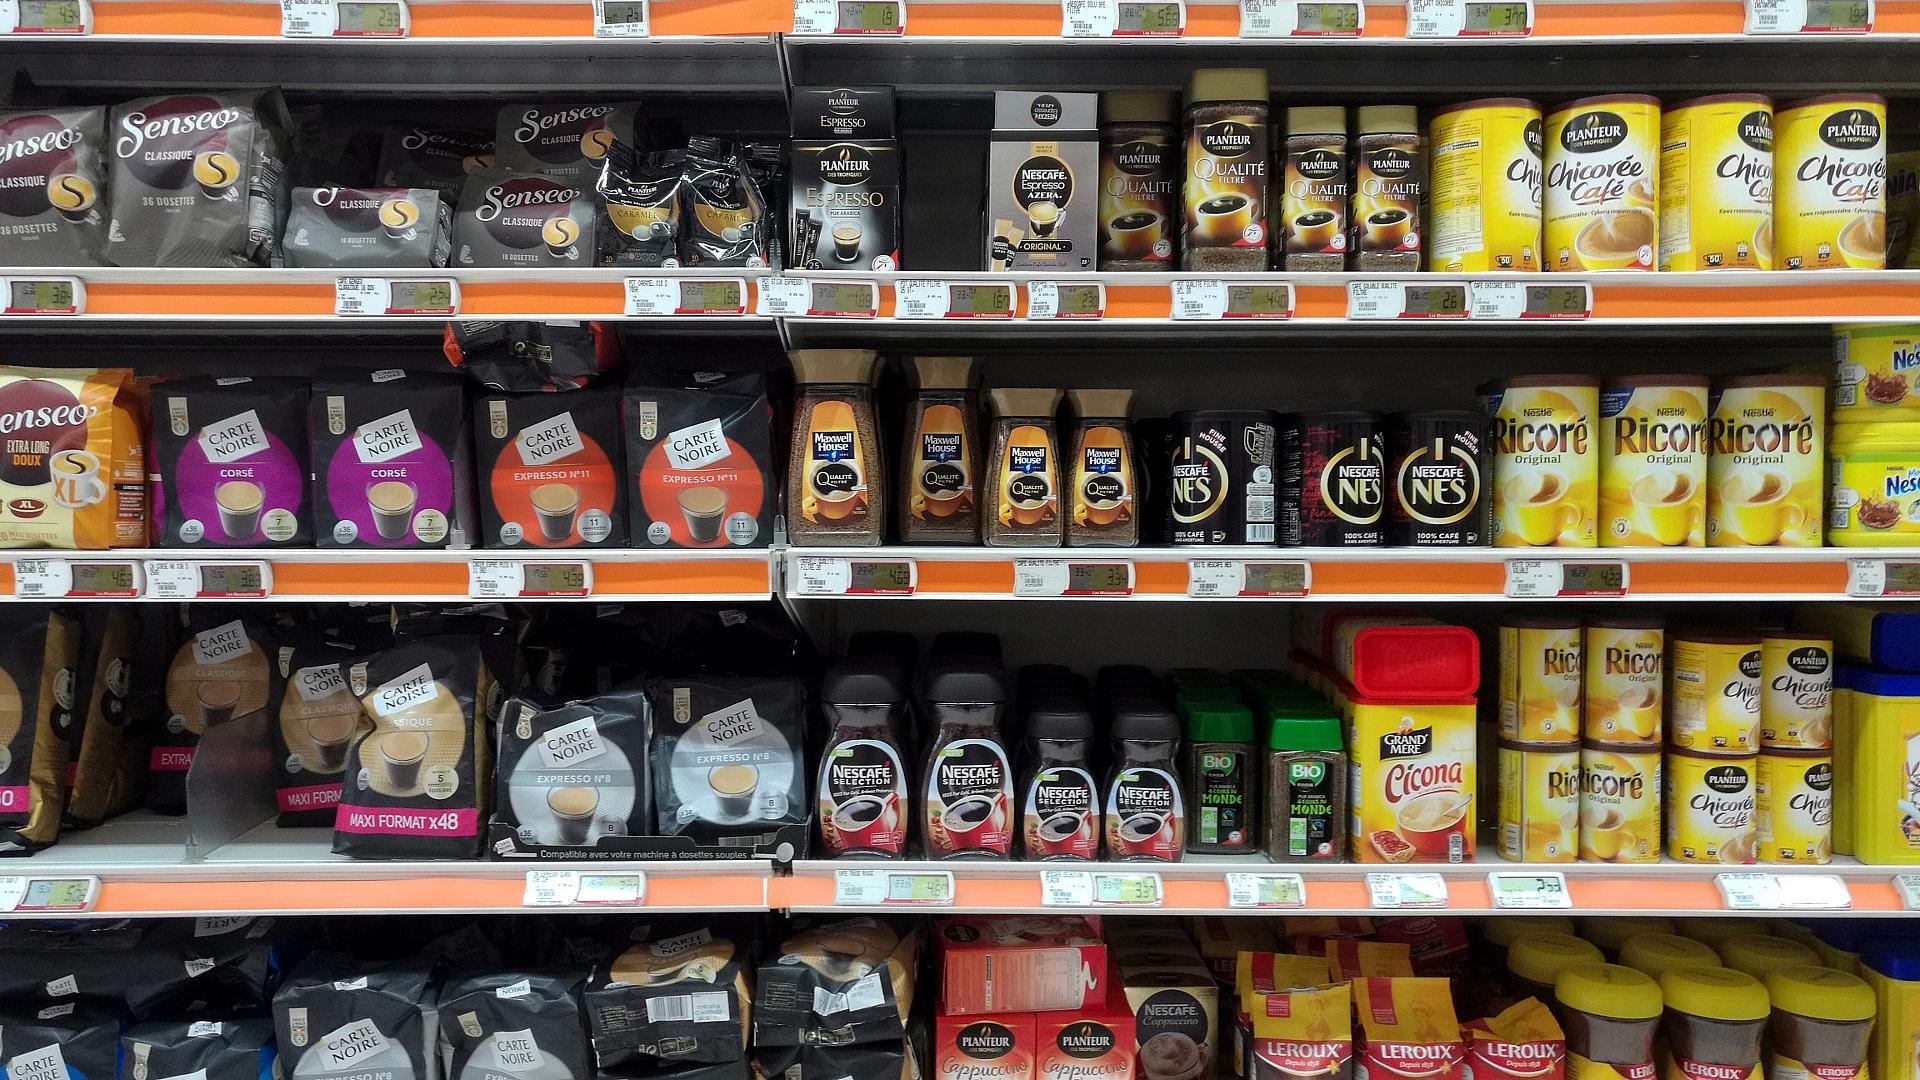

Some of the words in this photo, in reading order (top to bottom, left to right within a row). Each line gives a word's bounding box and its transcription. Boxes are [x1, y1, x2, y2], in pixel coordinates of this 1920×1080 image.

[827, 98, 859, 106] PLANTEUR
[820, 116, 866, 128] ESPRESSO
[116, 109, 239, 158] Senseo
[1566, 126, 1621, 143] PLANTEUR
[1827, 125, 1878, 137] PLANTEUR
[541, 134, 580, 145] CLASSIQUE
[1206, 134, 1251, 145] PLANTEUR
[145, 151, 193, 161] CLASSIQUE
[1119, 154, 1160, 164] PLANTEUR
[820, 159, 870, 171] PLANTEUR
[1194, 158, 1264, 182] QUALITÉ
[1301, 161, 1338, 170] PLANTEUR
[1373, 160, 1410, 169] PLANTEUR
[1548, 154, 1643, 190] Chicorée
[1022, 180, 1065, 192] Espresso
[1218, 176, 1245, 184] FILTRE
[1107, 176, 1173, 198] QUALITÉ
[1290, 179, 1347, 200] QUALITÉ
[1362, 178, 1420, 199] QUALITÉ
[1570, 179, 1624, 205] Café
[1832, 178, 1879, 203] Café
[157, 196, 195, 206] DOSETTES
[475, 186, 580, 221] Senseo
[805, 187, 884, 208] ESPRESSO
[340, 200, 379, 209] CLASSIQUE
[13, 222, 58, 234] DOSETTES
[502, 217, 543, 227] CLASSIQUE
[1024, 242, 1062, 250] ORIGINAL
[1501, 256, 1510, 265] 50
[1523, 408, 1553, 417] Nestlé
[1656, 407, 1685, 417] Nestlé
[1743, 408, 1775, 417] Nestlé
[208, 421, 255, 445] CARTE
[363, 420, 408, 445] CARTE
[526, 422, 570, 449] CARTE
[814, 432, 852, 443] Maxwell
[1209, 428, 1226, 442] FINE
[1464, 429, 1478, 443] FINE
[1493, 415, 1588, 455] Ricoré
[1615, 416, 1706, 456] Ricoré
[1708, 416, 1813, 456] Ricoré
[215, 433, 260, 458] NOIRE
[368, 433, 413, 458] NOIRE
[673, 429, 716, 453] CARTE
[924, 435, 959, 445] Maxwell
[1199, 432, 1227, 453] MOUSSE
[1454, 434, 1479, 455] MOUSSE
[7, 440, 28, 454] EXTRA
[30, 440, 50, 454] LONG
[531, 434, 574, 460] NOIRE
[678, 441, 722, 464] NOIRE
[818, 442, 848, 451] House
[928, 443, 956, 452] House
[1012, 448, 1044, 457] Maxwell
[1087, 448, 1119, 458] Maxwell
[13, 454, 41, 466] DOUX
[1015, 456, 1041, 464] House
[1090, 457, 1116, 465] House
[1515, 454, 1561, 465] Original
[1646, 455, 1692, 465] Original
[1733, 454, 1784, 466] Original
[220, 468, 254, 478] CORSÉ
[371, 467, 407, 478] CORSÉ
[514, 470, 567, 480] EXPRESSO
[663, 474, 714, 483] EXPRESSO
[925, 471, 959, 486] QUALITÉ
[1012, 481, 1043, 496] QUALITÉ
[1087, 481, 1118, 496] QUALITÉ
[1173, 477, 1211, 503] NES
[1339, 479, 1381, 505] NES
[1412, 478, 1466, 505] NES
[1187, 530, 1204, 538] CAFÉ
[200, 628, 240, 649] CARTE
[203, 640, 244, 659] NOIRE
[1792, 655, 1827, 665] PLANTEUR
[382, 675, 426, 700] CARTE
[708, 708, 751, 733] CARTE
[712, 719, 756, 744] NOIRE
[547, 727, 592, 751] CARTE
[552, 738, 598, 763] NOIRE
[161, 754, 192, 765] EXTRA
[697, 753, 750, 763] EXPRESSO
[753, 752, 769, 762] N°8
[438, 774, 444, 783] 5
[537, 774, 591, 784] EXPRESSO
[943, 778, 999, 786] SELECTION
[1384, 761, 1463, 804] Cicona
[1709, 774, 1746, 784] PLANTEUR
[288, 793, 310, 805] MAXI
[1203, 794, 1242, 804] MONDE
[1290, 805, 1332, 815] MONDE
[350, 813, 375, 828] MAXI
[379, 814, 426, 829] FORMAT
[428, 812, 458, 830] x48
[540, 849, 586, 860] Compatible
[611, 850, 631, 858] votre
[634, 849, 670, 858] machine
[673, 849, 678, 858] à
[680, 849, 713, 858] dosettes
[1142, 1016, 1199, 1026] Cappuccino
[328, 1026, 375, 1051] CARTE
[962, 1036, 1010, 1047] PLANTEUR
[1063, 1036, 1110, 1047] PLANTEUR
[332, 1036, 381, 1064] NOIRE
[498, 1039, 530, 1052] CARTE
[1267, 1041, 1340, 1058] LEROUX
[1381, 1044, 1453, 1059] LEROUX
[1487, 1041, 1560, 1058] LEROUX
[501, 1052, 536, 1065] NOIRE
[1285, 1059, 1304, 1068] Depuis
[1506, 1060, 1524, 1068] Depuis
[15, 1056, 56, 1076] CARTE
[942, 1055, 1029, 1080] Cappuccino
[1042, 1055, 1128, 1080] Cappuccino
[1684, 1062, 1740, 1080] LEROUX
[1817, 1067, 1854, 1077] LEROUX
